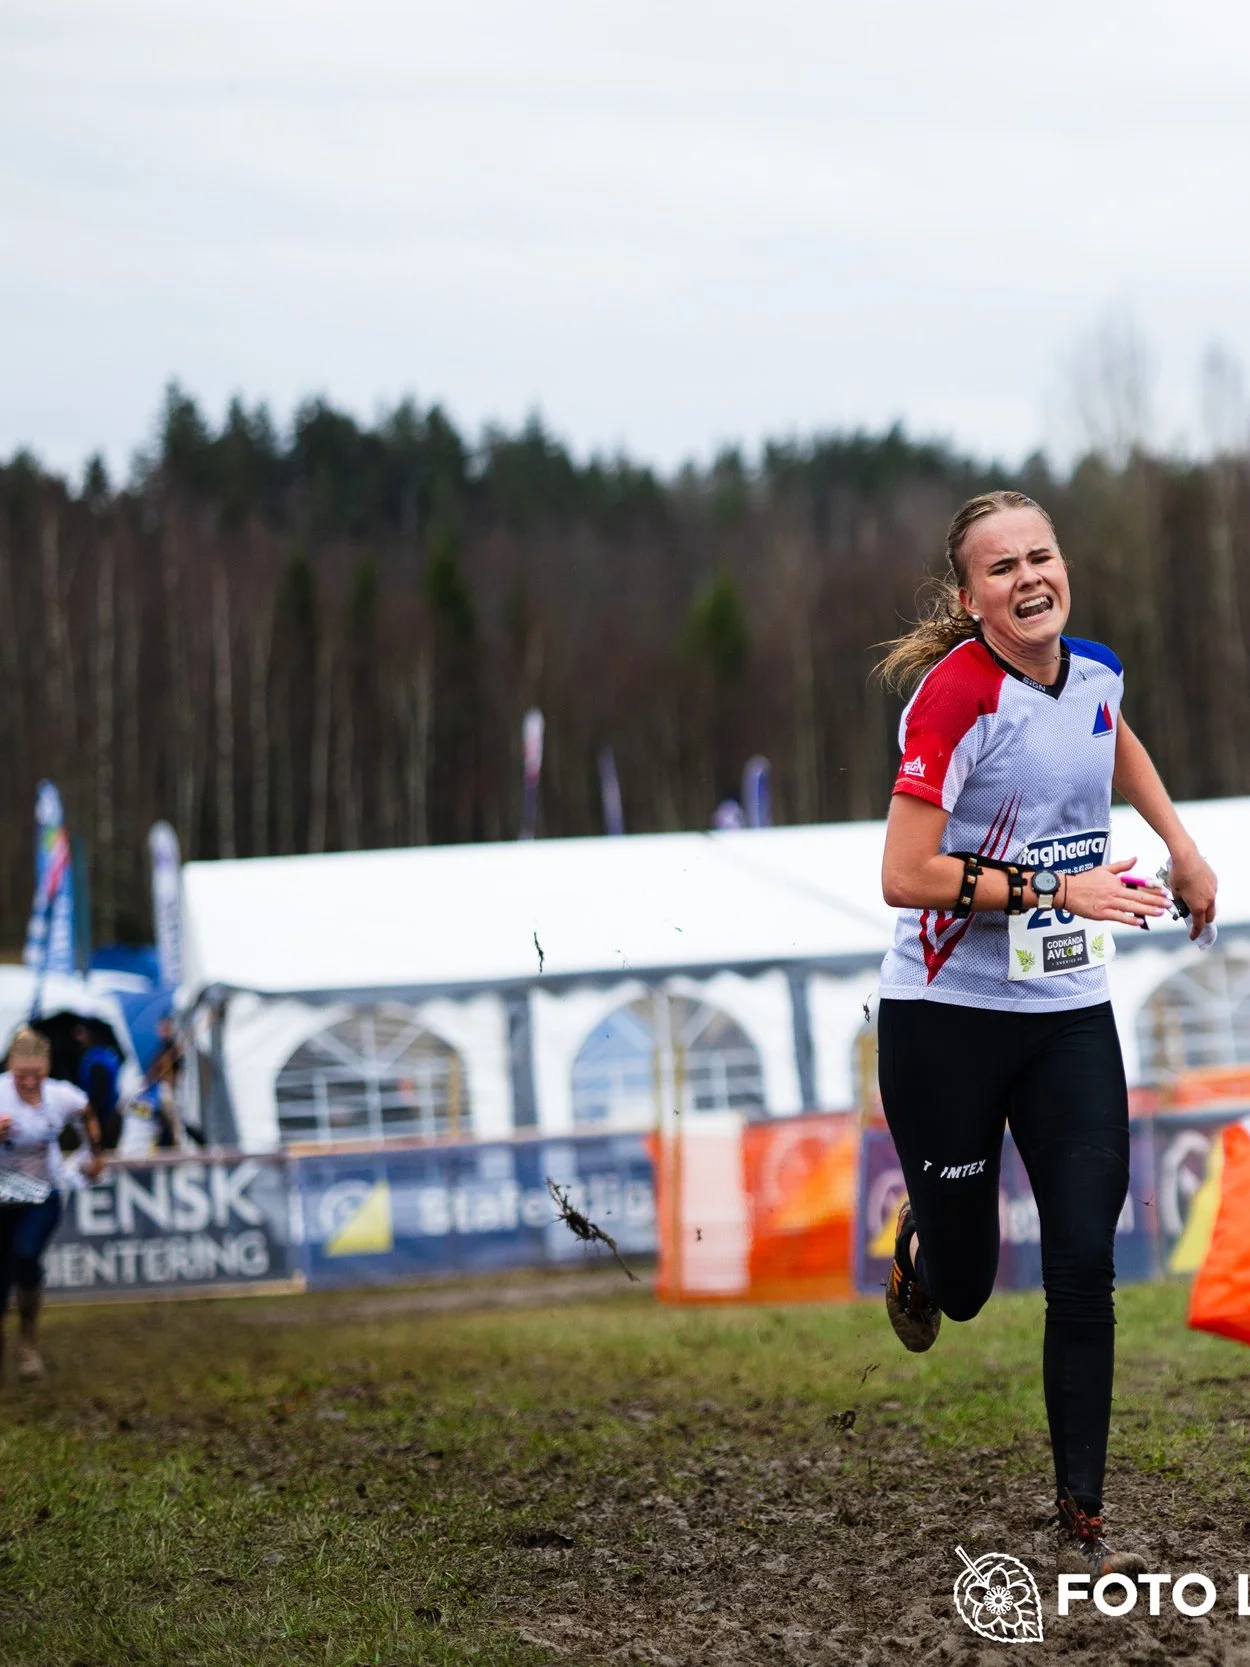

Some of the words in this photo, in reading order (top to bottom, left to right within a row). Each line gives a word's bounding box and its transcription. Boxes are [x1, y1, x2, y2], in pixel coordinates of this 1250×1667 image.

[1047, 935, 1084, 949] GODKÄNDA
[1047, 943, 1084, 960] AVLOPP
[923, 1160, 987, 1179] TIMTEX
